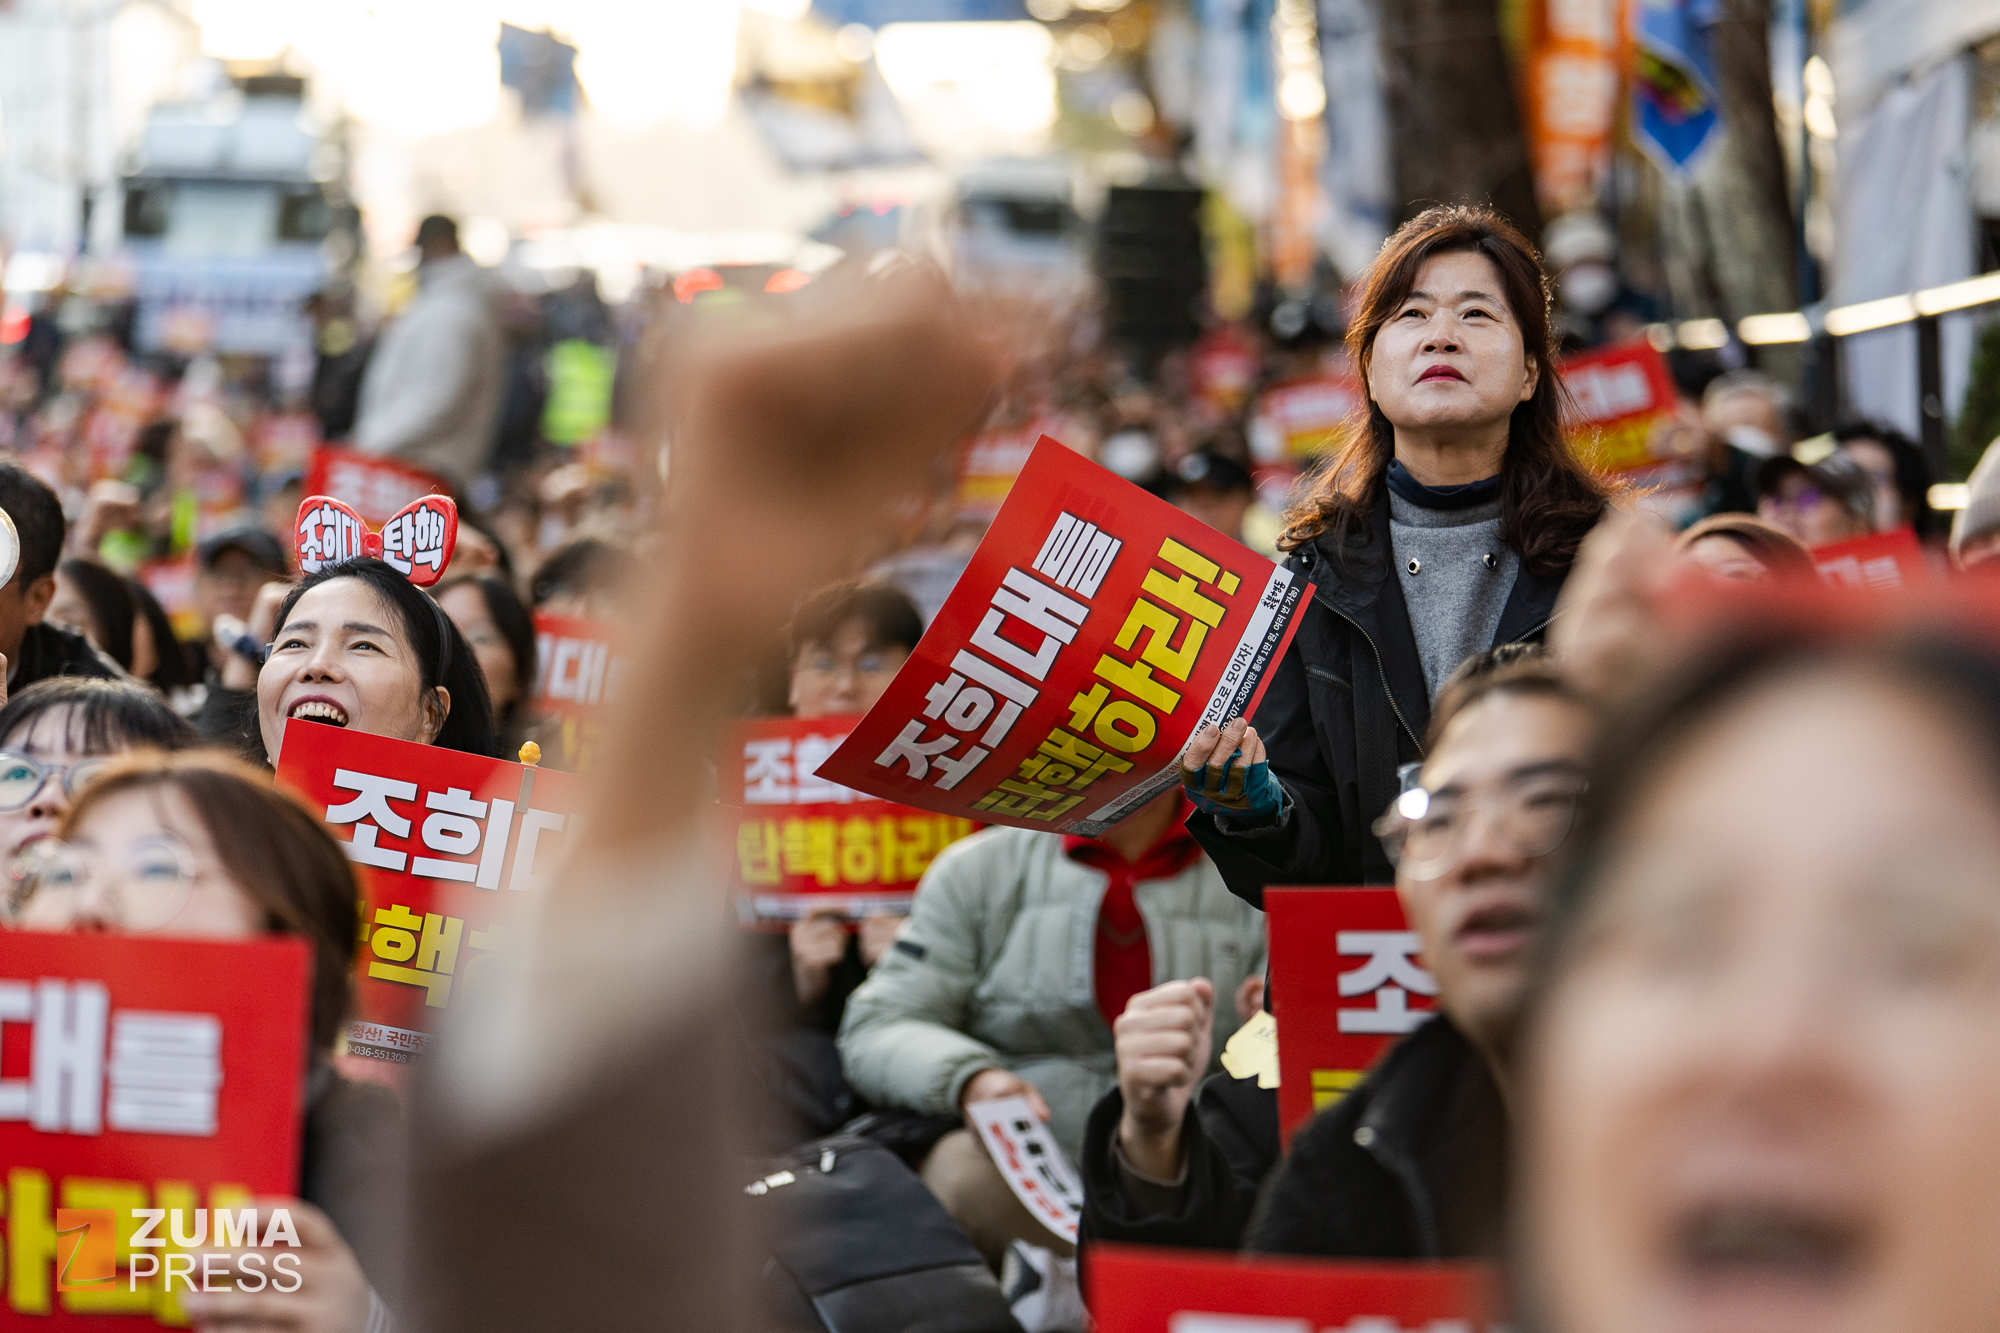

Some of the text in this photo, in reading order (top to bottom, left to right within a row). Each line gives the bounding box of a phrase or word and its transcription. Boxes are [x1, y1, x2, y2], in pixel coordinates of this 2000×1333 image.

[300, 502, 446, 575] 조희대 탄핵
[874, 511, 1122, 791] 조희대를
[1272, 614, 1287, 631] 여러
[1280, 603, 1292, 615] 번
[972, 537, 1241, 821] 탄핵하라!
[1225, 642, 1254, 686] 모이자!
[744, 734, 880, 804] 조희
[347, 1023, 430, 1050] 청산! 국민주
